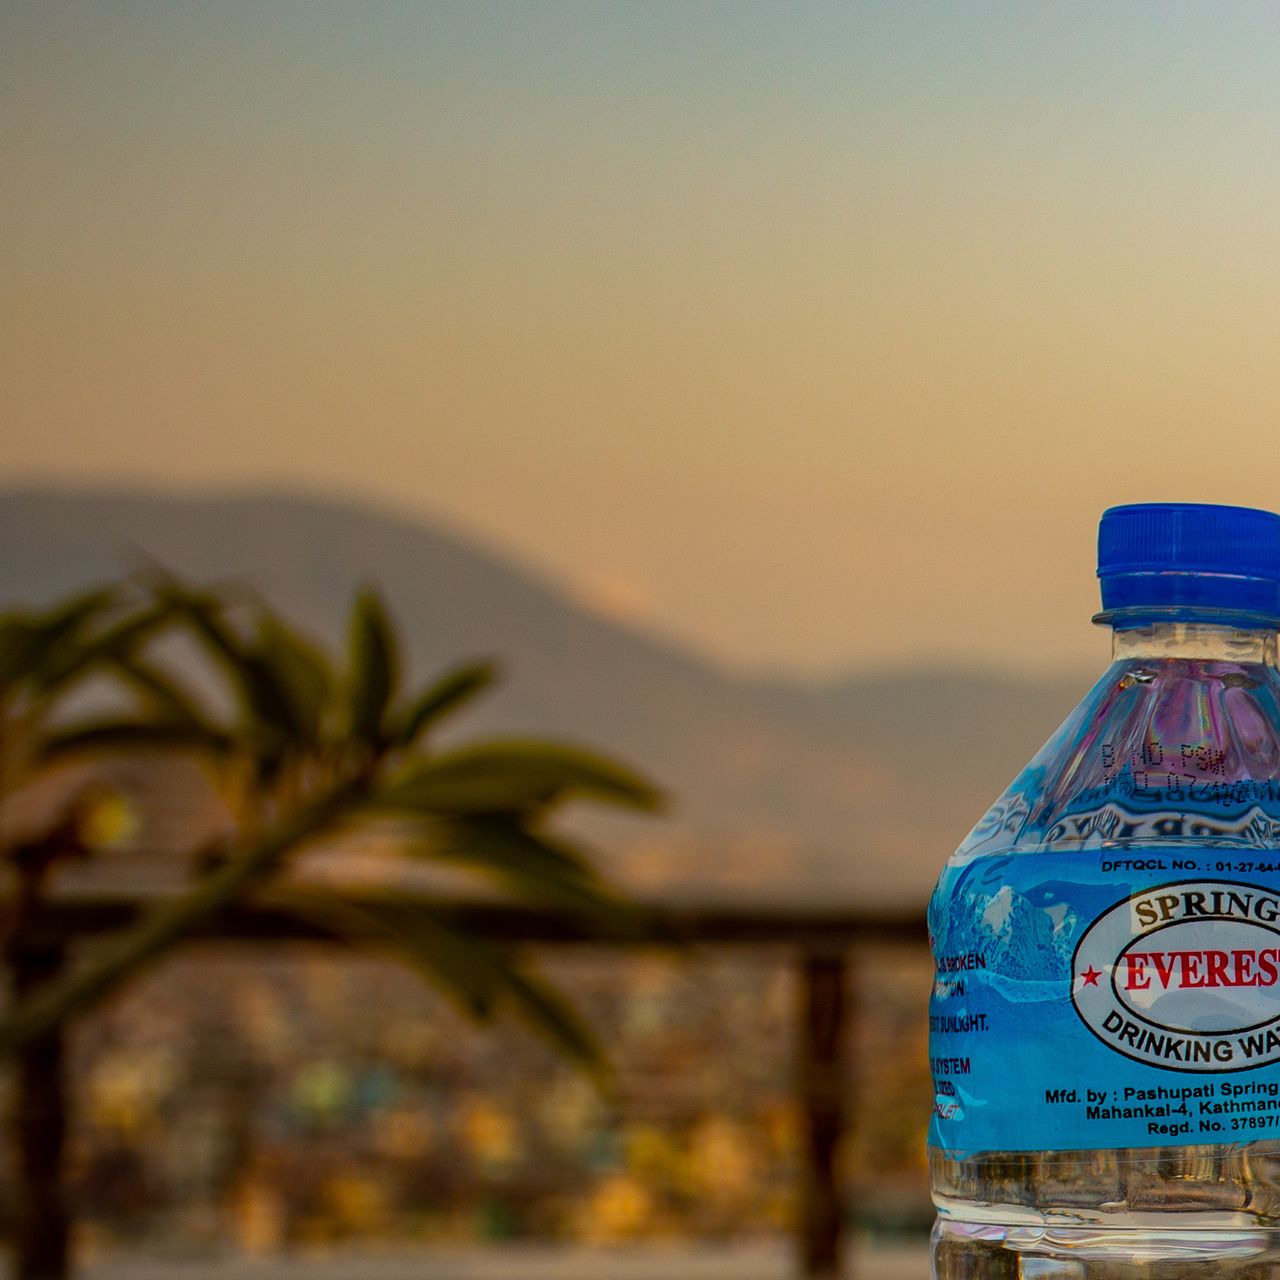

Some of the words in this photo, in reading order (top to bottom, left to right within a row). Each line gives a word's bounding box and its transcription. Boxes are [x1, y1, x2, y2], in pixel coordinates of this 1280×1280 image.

[1101, 859, 1168, 872] DFTQCL
[1172, 860, 1201, 871] NO.
[1134, 891, 1280, 928] SPRING
[1101, 1009, 1234, 1063] DRINKING
[936, 1056, 971, 1075] SYSTEM
[1045, 1089, 1081, 1104] Mfd.
[1087, 1089, 1107, 1105] by
[1123, 1084, 1214, 1102] Pashupati
[1220, 1081, 1279, 1098] Spring
[1086, 1102, 1193, 1120] Mahankal-4,
[1147, 1122, 1193, 1136] Regd.
[1199, 1120, 1226, 1132] No.
